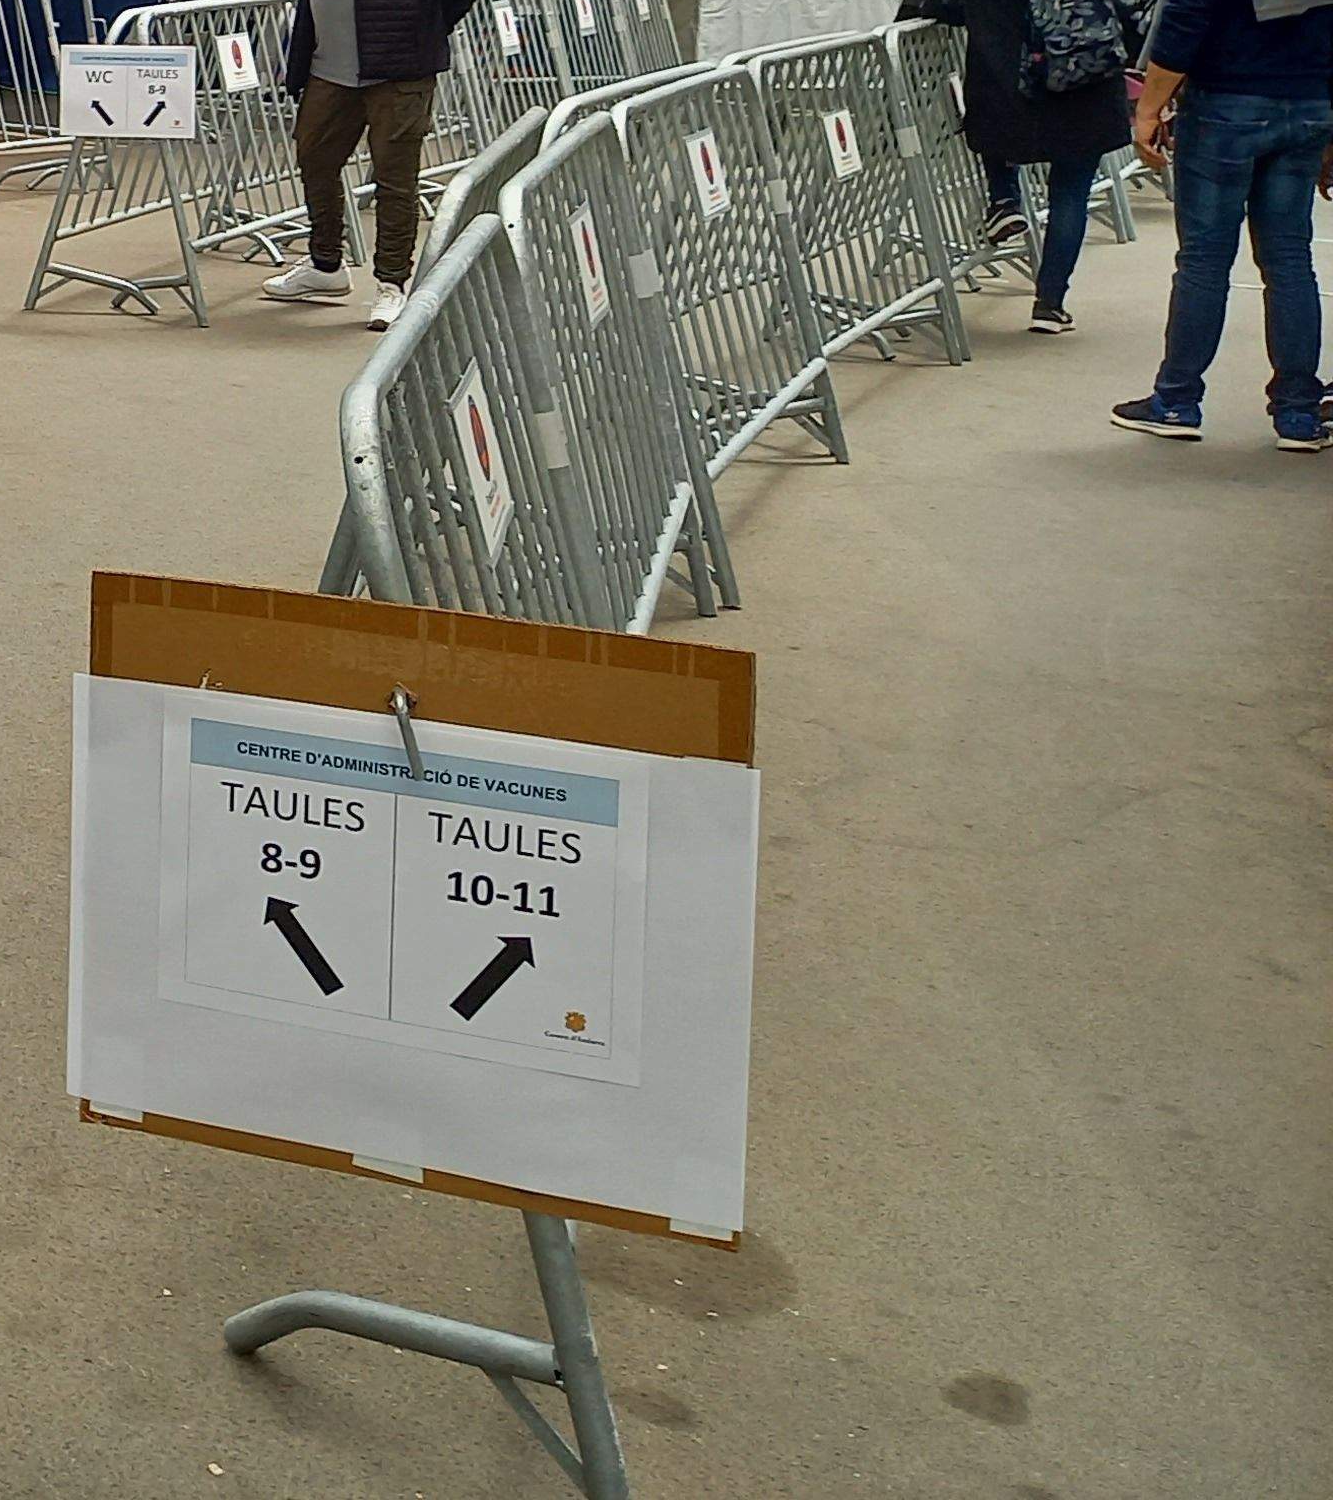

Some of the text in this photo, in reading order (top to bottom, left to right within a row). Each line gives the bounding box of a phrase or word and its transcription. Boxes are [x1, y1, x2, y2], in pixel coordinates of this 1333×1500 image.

[85, 70, 113, 83] WC
[137, 69, 179, 79] TAULES
[148, 85, 166, 94] 8-9
[237, 741, 568, 803] CENTRE D'ADMINISTRCIÓ DE VACUNES
[220, 781, 365, 833] TAULES
[428, 811, 583, 865] TAULES
[260, 842, 322, 880] 8-9
[446, 871, 561, 919] 10-11
